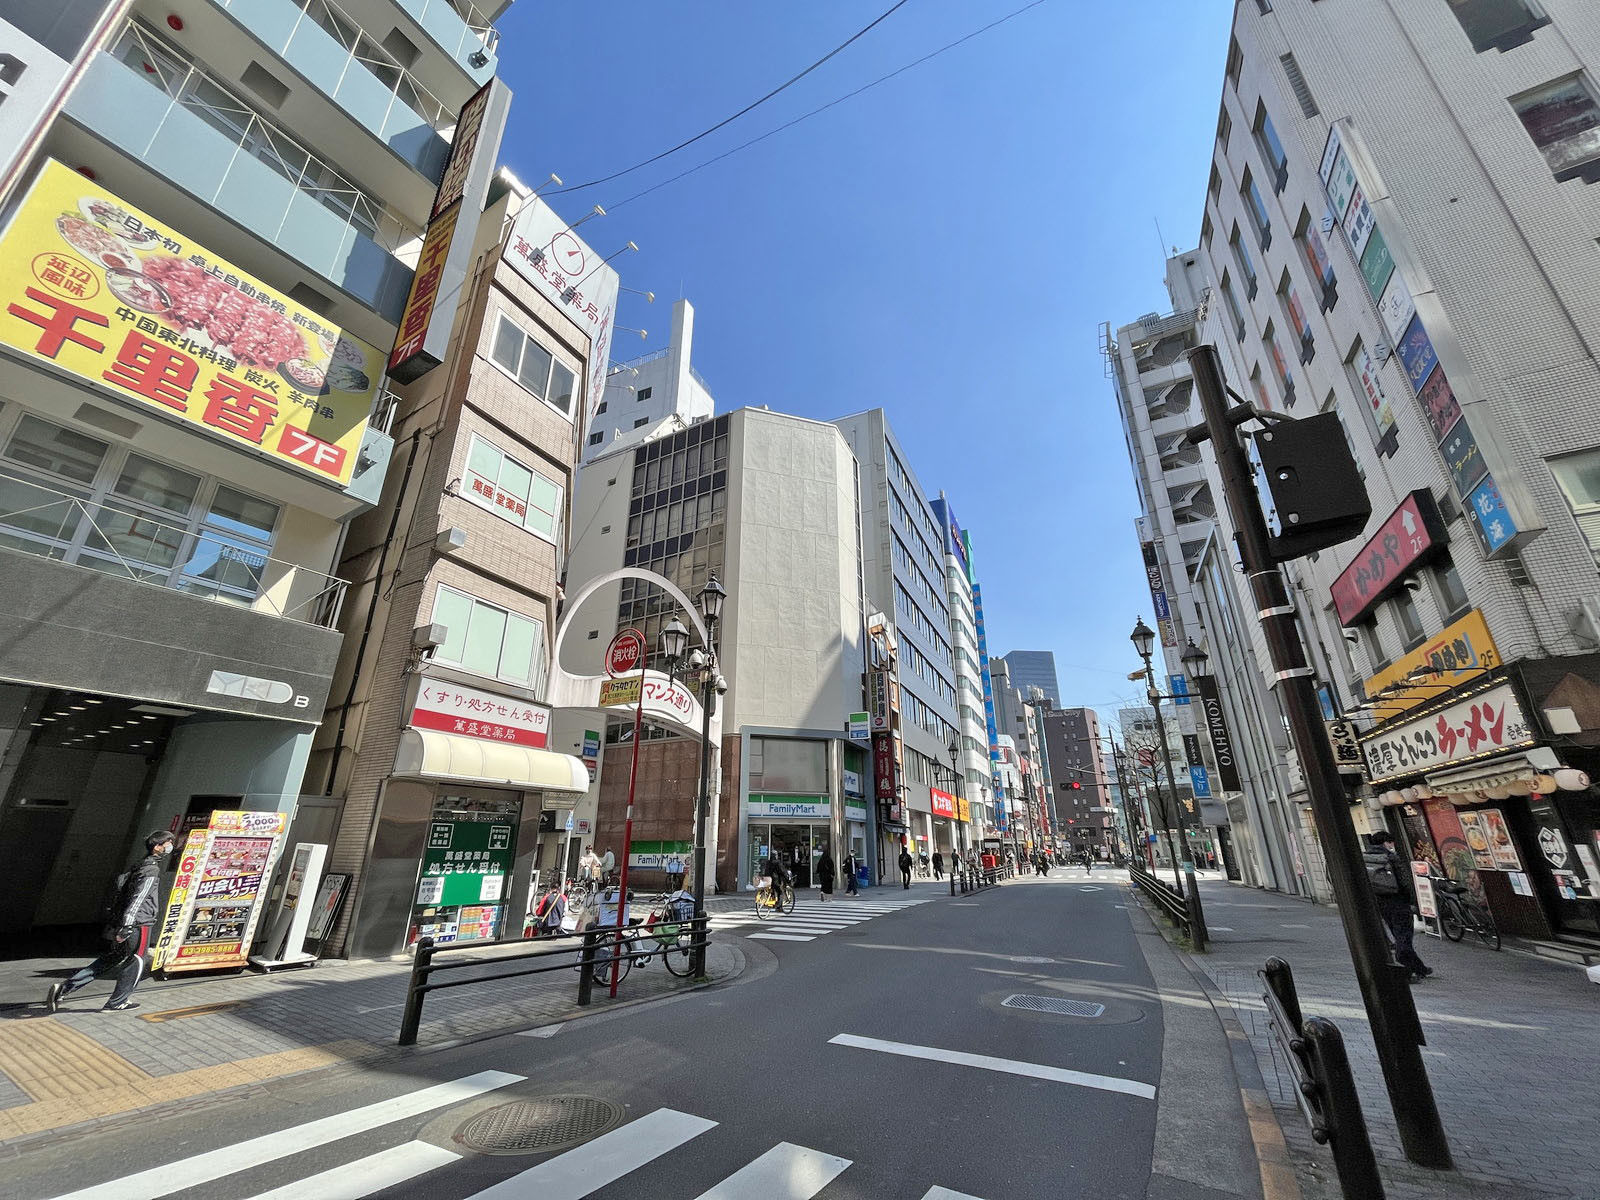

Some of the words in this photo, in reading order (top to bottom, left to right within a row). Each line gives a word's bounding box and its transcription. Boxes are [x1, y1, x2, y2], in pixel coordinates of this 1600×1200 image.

[40, 267, 86, 298] 風味
[123, 214, 183, 255] 日本初
[292, 311, 337, 344] 新登場
[403, 231, 449, 342] 千里香
[395, 333, 422, 365] 7F
[7, 286, 280, 446] 千里香
[115, 306, 238, 373] 中国東北料理
[243, 368, 281, 395] 炭火
[287, 389, 336, 420] 羊肉串
[289, 430, 340, 469] 7F
[472, 477, 526, 519] 萬盛堂薬局
[1477, 492, 1505, 543] 花海
[1410, 535, 1424, 555] 2F
[613, 645, 637, 664] 消火栓
[1480, 649, 1494, 668] 2F
[294, 695, 310, 708] B
[643, 682, 692, 714] マンス通り
[454, 719, 516, 741] 萬盛堂薬局
[1205, 698, 1232, 766] KOMEHYO
[769, 804, 816, 816] FamilyMart
[428, 862, 501, 876] 処方せん受付
[445, 851, 491, 861] 萬盛堂薬局
[637, 855, 680, 866] FamilyMart
[197, 878, 243, 896] 出会い
[229, 886, 259, 899] カフェ
